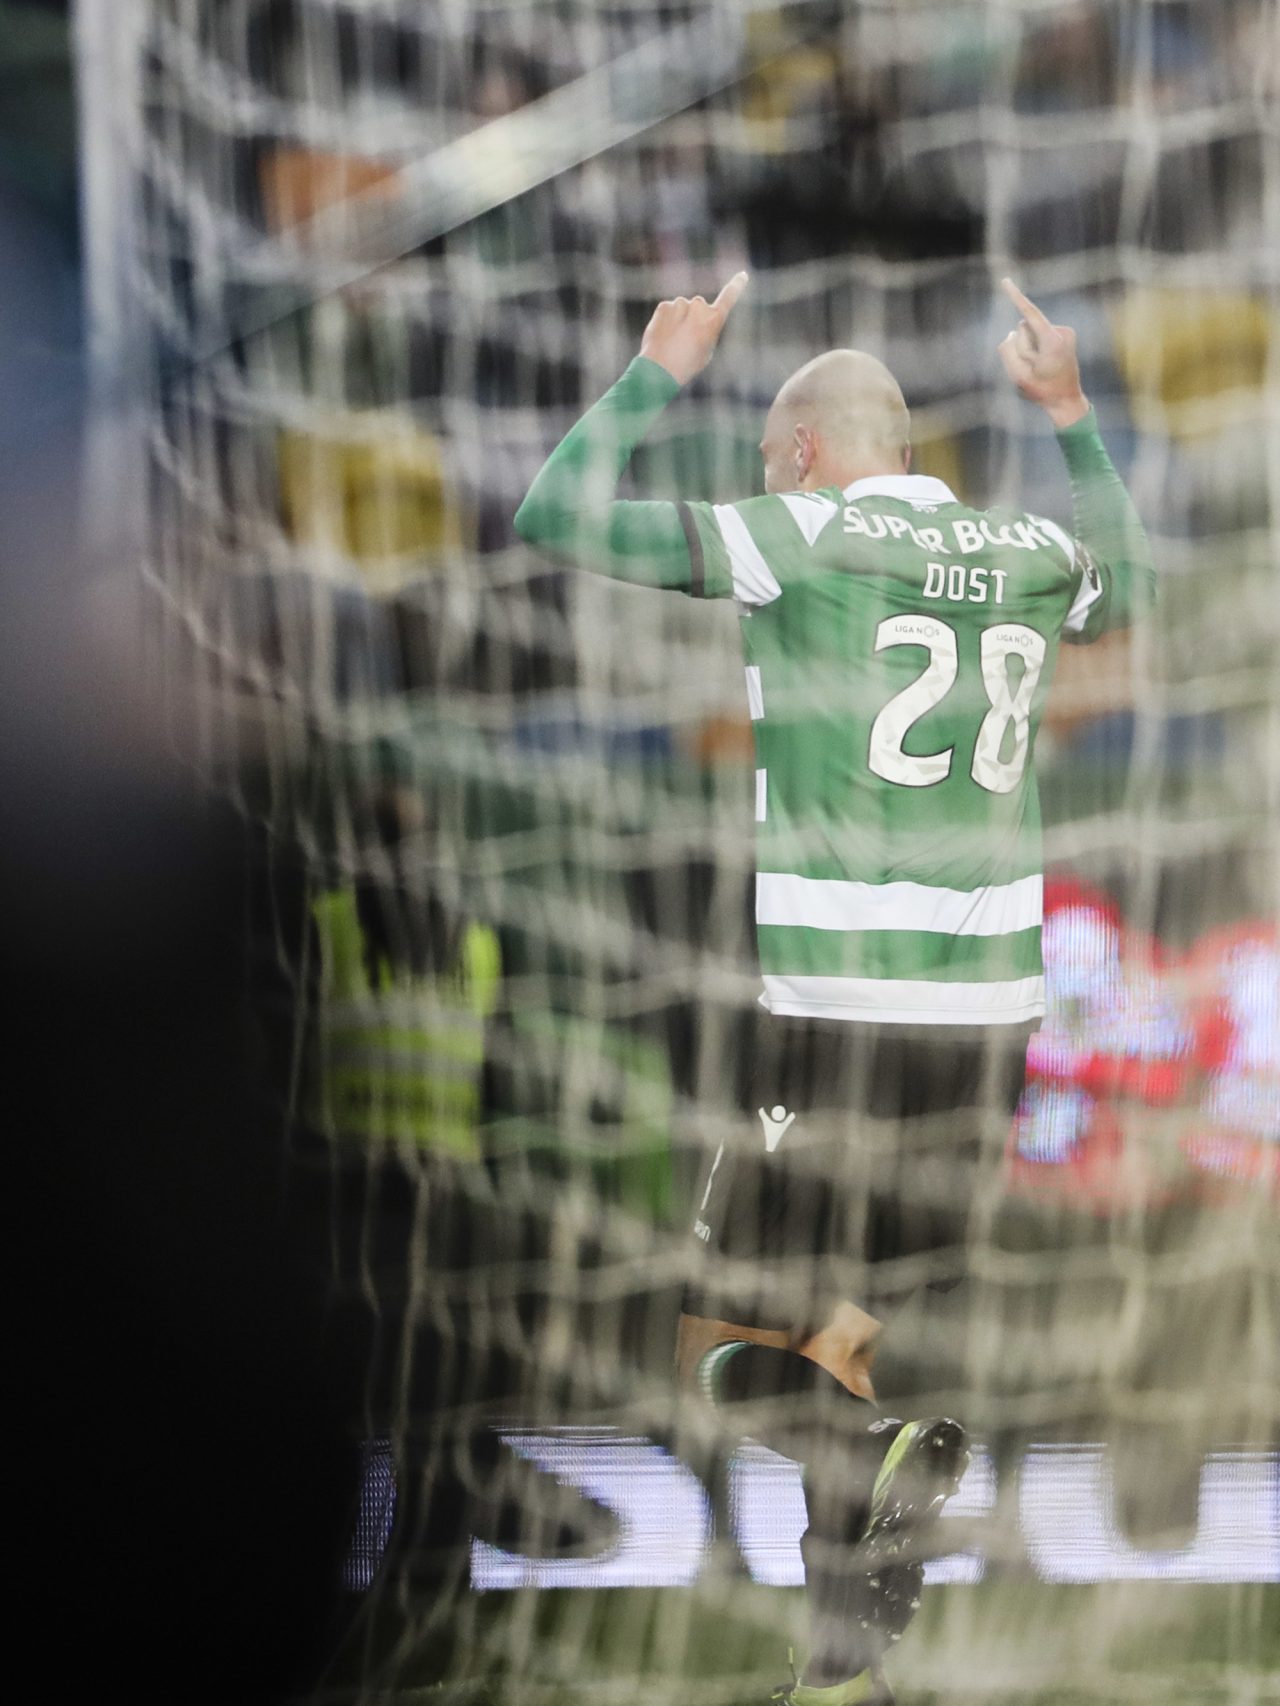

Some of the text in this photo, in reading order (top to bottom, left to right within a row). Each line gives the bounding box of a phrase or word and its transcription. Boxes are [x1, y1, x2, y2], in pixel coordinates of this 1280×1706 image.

[923, 562, 1008, 604] DOST
[894, 625, 914, 633] LIGA
[996, 634, 1013, 642] LIGA
[868, 613, 1047, 794] 28
